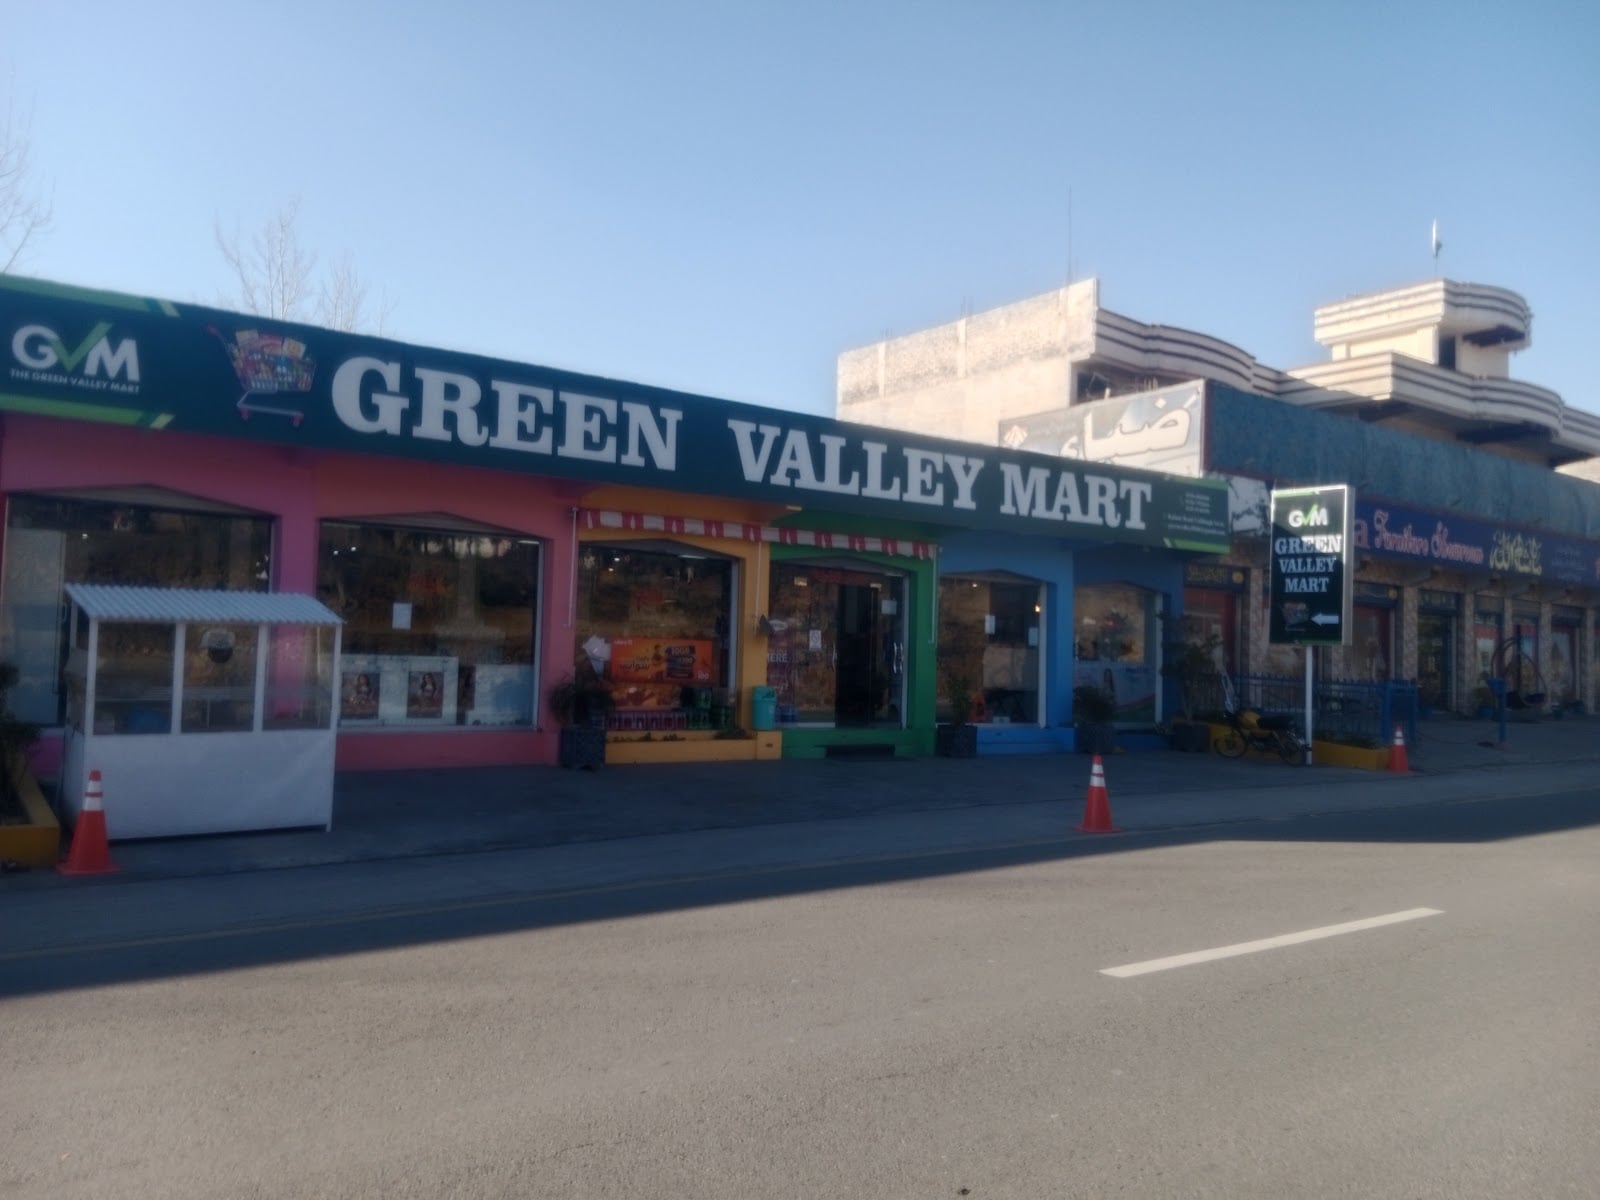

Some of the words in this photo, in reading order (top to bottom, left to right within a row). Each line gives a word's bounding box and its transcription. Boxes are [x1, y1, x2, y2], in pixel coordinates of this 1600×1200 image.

[10, 368, 30, 380] THE
[32, 371, 68, 384] GREEN
[70, 377, 107, 390] VALLEY
[110, 381, 139, 393] MART
[331, 356, 683, 471] GREEN
[727, 419, 985, 509] VALLEY
[1000, 463, 1151, 530] MART
[1274, 534, 1342, 555] GREEN
[1279, 555, 1337, 574] VALLEY
[1284, 577, 1330, 593] MART
